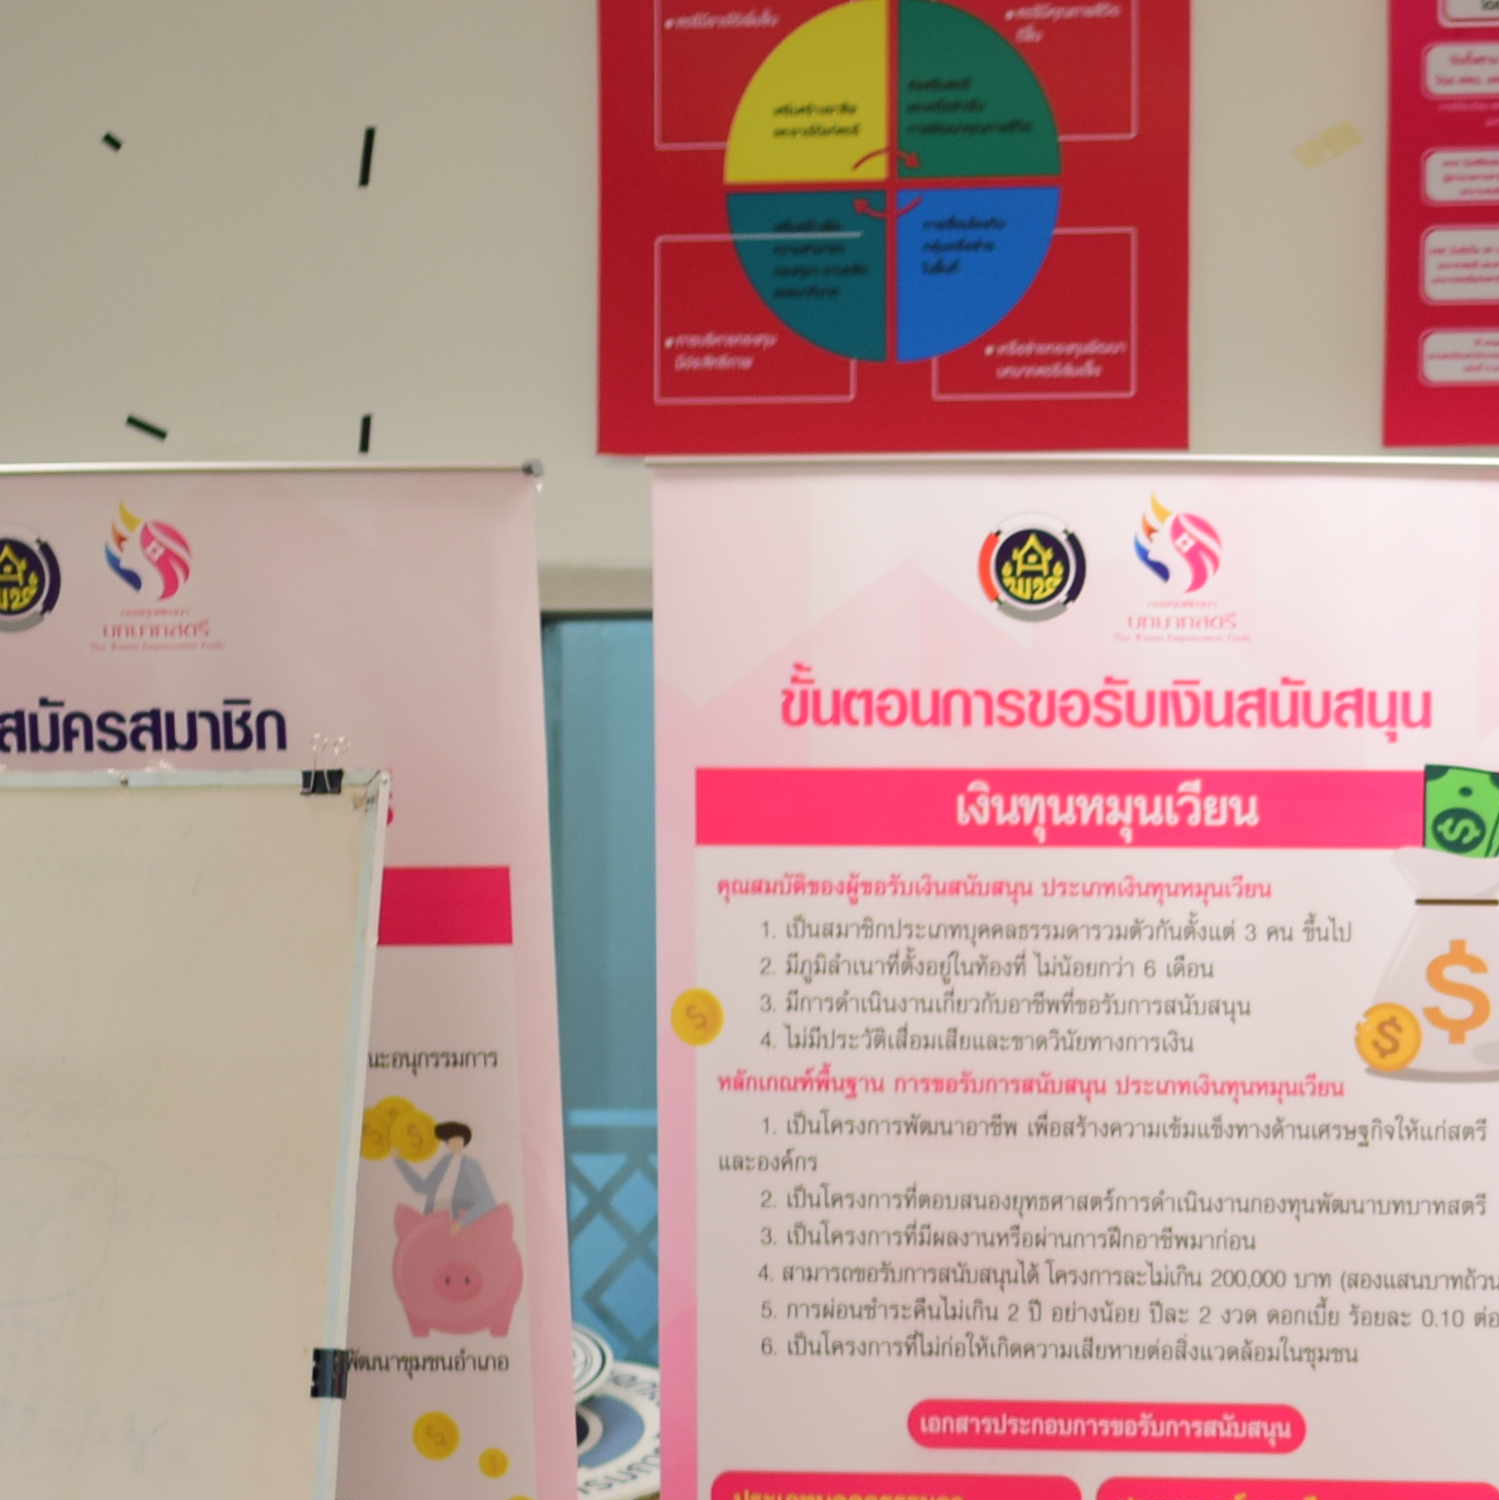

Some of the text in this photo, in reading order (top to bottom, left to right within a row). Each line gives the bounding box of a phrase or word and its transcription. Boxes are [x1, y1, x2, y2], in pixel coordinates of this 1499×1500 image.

[781, 664, 1432, 743] ขั้นตอนการขอรับเงินสนับสนุน
[956, 780, 1260, 843] เงินทุนหมุนเวียน
[717, 872, 1273, 906] คุณสมบัติของผู้ขอรับเงินสนับสนุน ประเภทเงินทุนหมุนเวียน
[1266, 922, 1294, 942] คน
[1303, 912, 1353, 943] ขึ้นไป
[1033, 951, 1135, 979] ไม่น้อยกว่า
[1144, 959, 1156, 978] 6
[1166, 954, 1215, 979] เดือน
[718, 1063, 1345, 1105] หลักเกณฑ์พื้นฐาน การขอรับการสนับสนุน ประเภทเงินทุนหมุนเวียน
[786, 1109, 1018, 1137] เป็นโครงการพัฒนาอาชีพ
[718, 1148, 818, 1172] และองค์กร
[782, 1258, 1039, 1292] สามารถขอรับการสนับสนุนได้
[1045, 1259, 1202, 1289] โครงการละไม่เกิน
[1211, 1269, 1286, 1290] 200,000
[1294, 1271, 1331, 1289] บาท
[786, 1295, 998, 1322] การผ่อนชำระคืนไม่เกิน
[1051, 1300, 1140, 1324] อย่างน้อย
[1150, 1302, 1189, 1326] ปีละ
[1221, 1310, 1257, 1326] งวด
[1267, 1296, 1340, 1327] ดอกเบี้ย
[1349, 1305, 1411, 1328] ร้อยละ
[1421, 1309, 1464, 1328] 0.10
[919, 1409, 1292, 1445] เอกสารประกอบการขอรับการสนับสนุน
